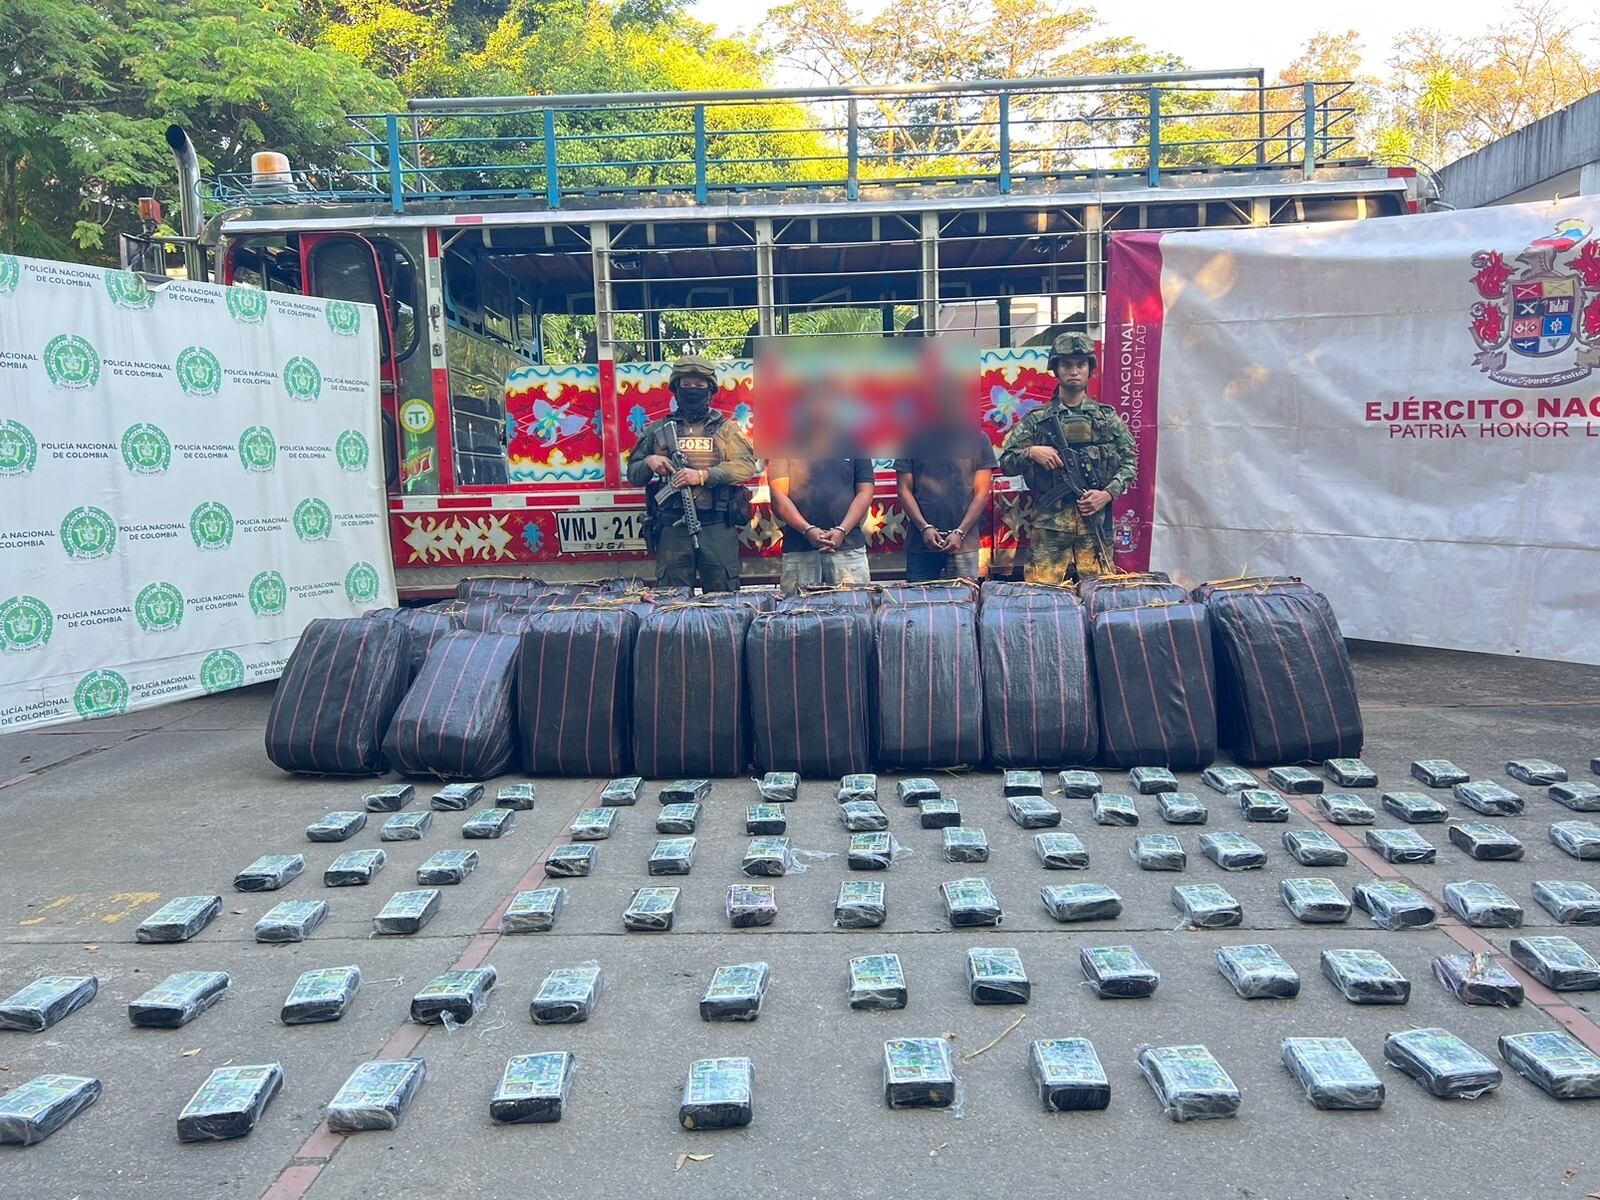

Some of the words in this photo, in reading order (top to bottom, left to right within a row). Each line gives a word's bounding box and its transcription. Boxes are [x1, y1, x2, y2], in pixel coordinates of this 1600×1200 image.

[60, 269, 101, 280] NACIONAL
[36, 275, 47, 283] DE
[50, 277, 92, 288] COLOMBIA
[188, 288, 222, 297] NACIONAL
[180, 295, 214, 304] COLOMBIA
[1134, 325, 1146, 385] LEALTAD
[134, 362, 172, 371] NACIONAL
[1120, 317, 1134, 406] NACIONAL
[125, 370, 163, 378] COLOMBIA
[1132, 390, 1143, 438] HONOR
[1365, 396, 1524, 421] EJÉRCITO
[1390, 423, 1467, 439] PATRIA
[1480, 421, 1569, 438] HONOR
[41, 442, 74, 450] POLICÍA
[678, 439, 710, 450] GOES
[10, 530, 55, 538] NACIONAL
[141, 532, 178, 540] COLOMBIA
[0, 540, 45, 548] COLOMBIA
[213, 592, 245, 602] NACIONAL
[206, 601, 238, 610] COLOMBIA
[57, 612, 88, 621] POLICÍA
[90, 606, 132, 616] NACIONAL
[81, 616, 122, 626] COLOMBIA
[161, 674, 196, 686] NACIONAL
[152, 684, 188, 696] COLOMBIA
[25, 698, 69, 711] NACIONAL
[2, 717, 12, 725] DE
[15, 708, 59, 722] COLOMBIA
